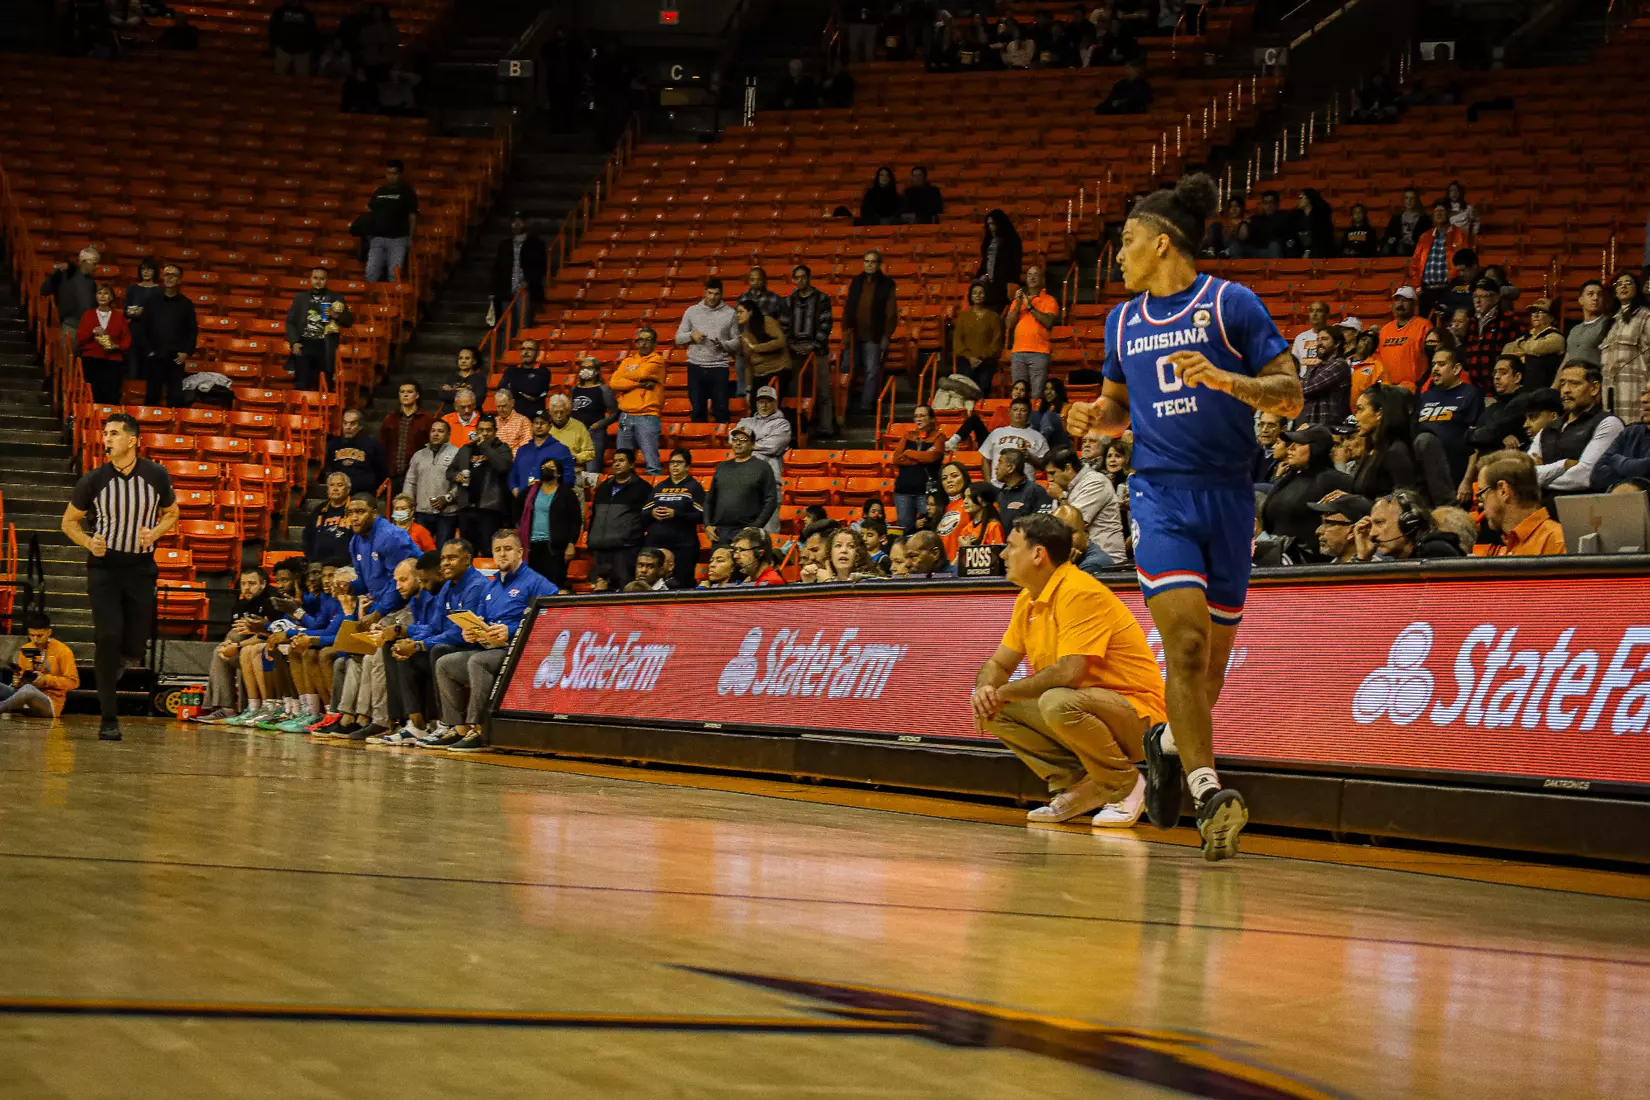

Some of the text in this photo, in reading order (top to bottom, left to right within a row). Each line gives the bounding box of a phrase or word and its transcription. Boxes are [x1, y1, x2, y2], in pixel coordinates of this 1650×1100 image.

[1265, 48, 1277, 65] C
[510, 60, 521, 76] B
[671, 64, 683, 80] C
[1126, 327, 1209, 356] LOUISIANA
[1156, 355, 1183, 393] 0
[1152, 396, 1198, 418] TECH
[1418, 406, 1458, 422] 915
[965, 546, 992, 568] POSS
[1543, 779, 1590, 790] DAKTRONICS
